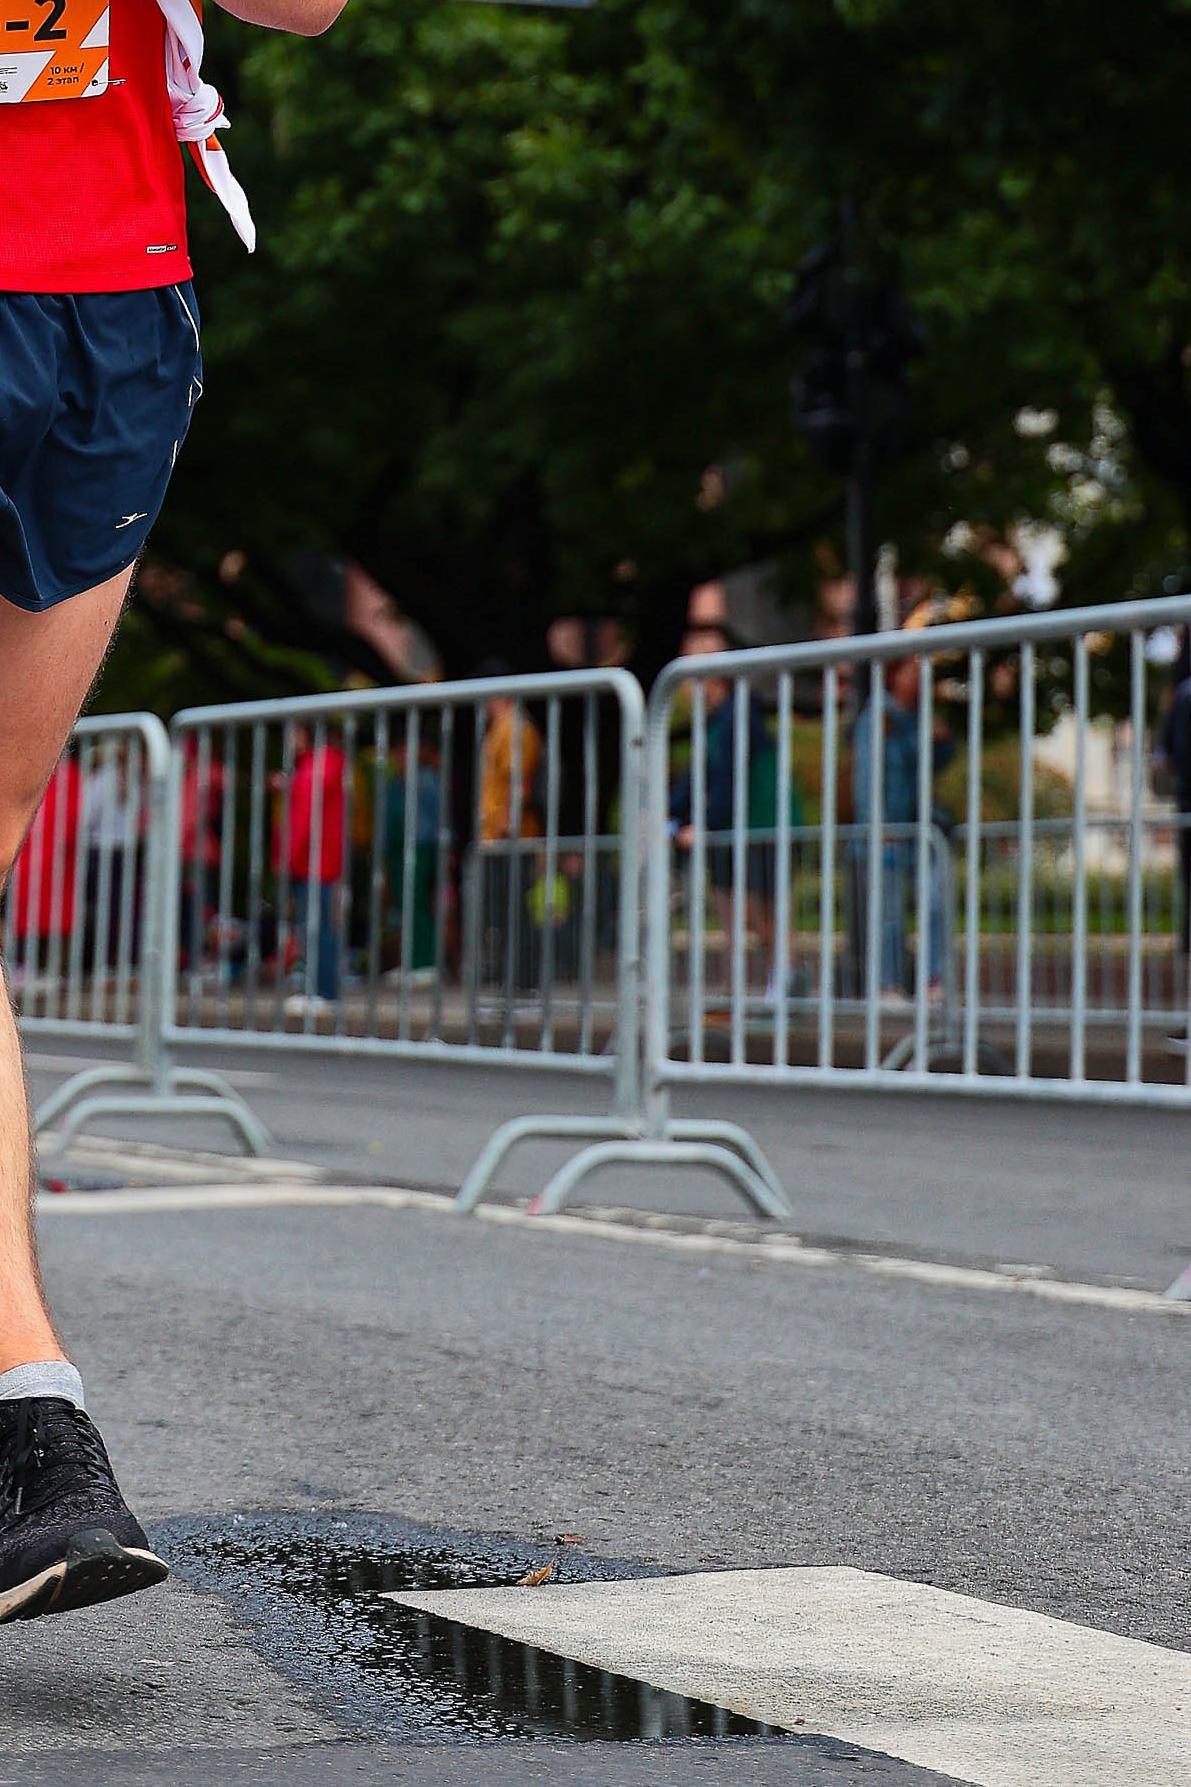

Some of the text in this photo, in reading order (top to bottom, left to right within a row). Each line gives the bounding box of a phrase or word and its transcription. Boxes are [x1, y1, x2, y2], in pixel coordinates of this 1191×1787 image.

[50, 66, 61, 74] 10
[64, 66, 77, 74] км
[56, 76, 79, 84] этап
